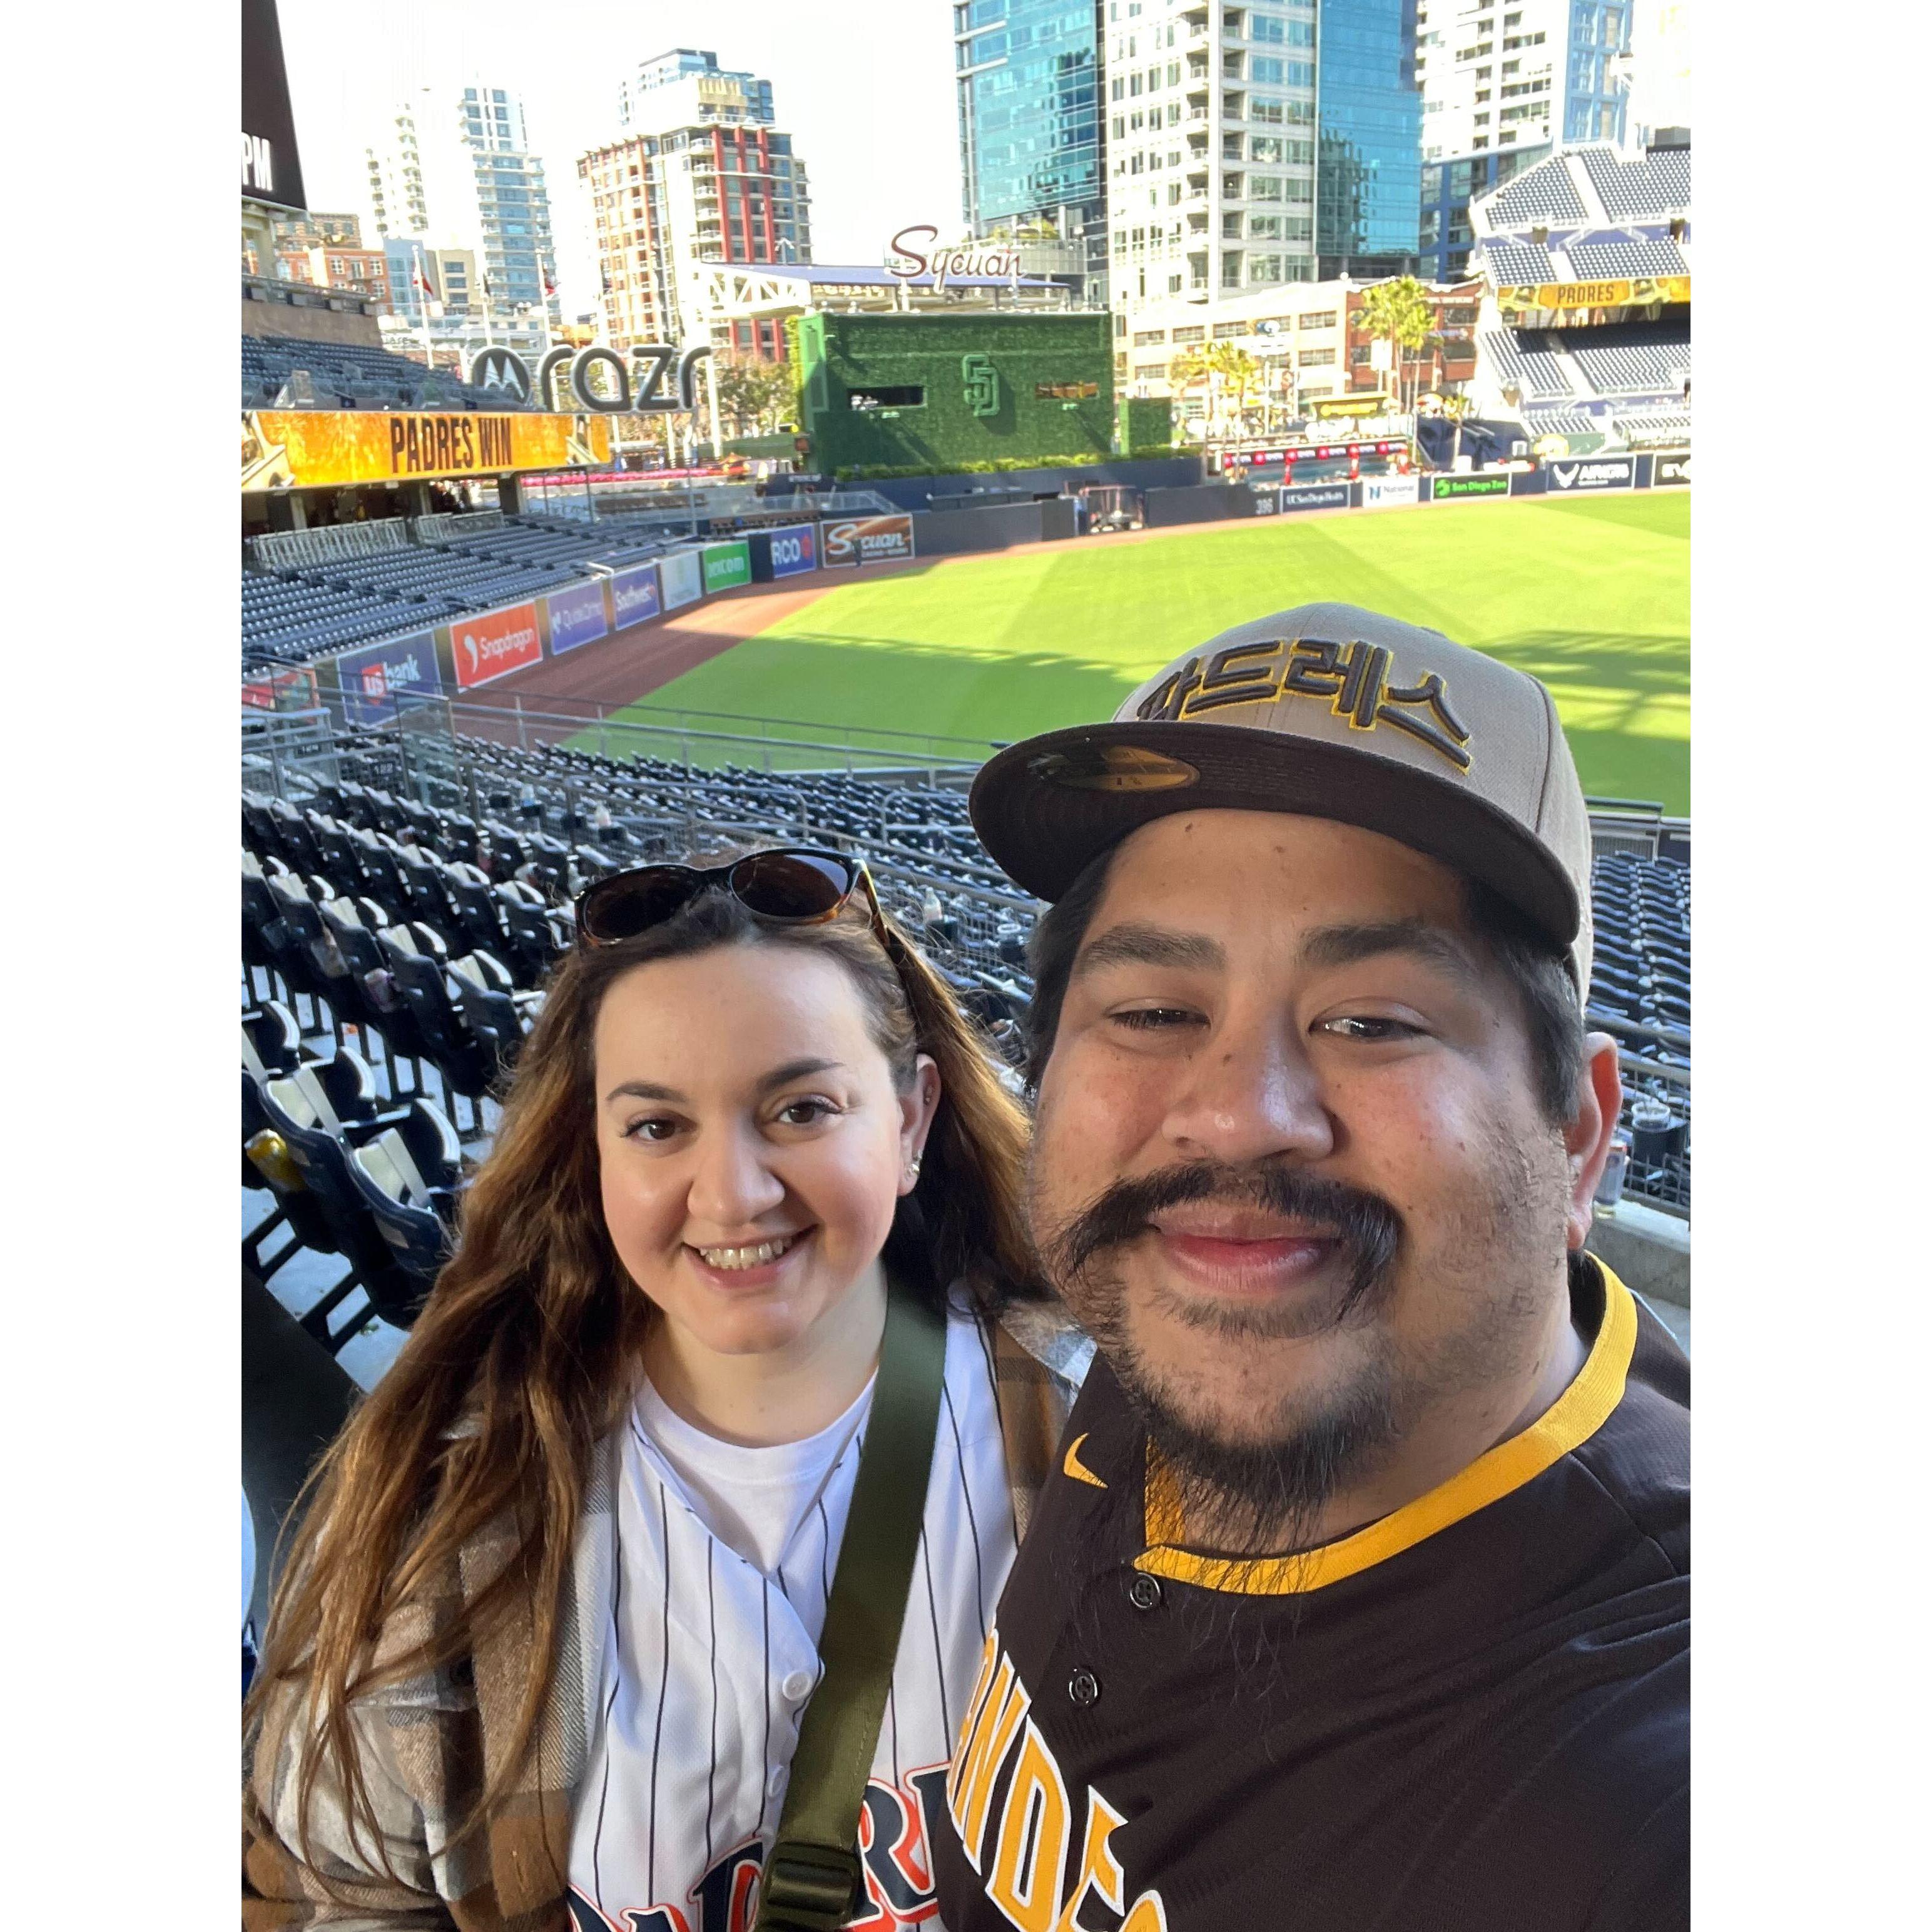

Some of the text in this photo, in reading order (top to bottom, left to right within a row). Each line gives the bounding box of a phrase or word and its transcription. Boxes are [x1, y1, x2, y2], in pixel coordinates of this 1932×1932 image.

[242, 131, 273, 191] PM
[889, 224, 1024, 293] Sycuan
[1557, 283, 1615, 304] PADRES
[539, 345, 711, 411] razr
[390, 417, 512, 473] PADRES WIN
[771, 537, 801, 565] RCO
[828, 523, 905, 556] Scuan
[480, 628, 534, 660] Snapdragon
[383, 654, 422, 689] bank
